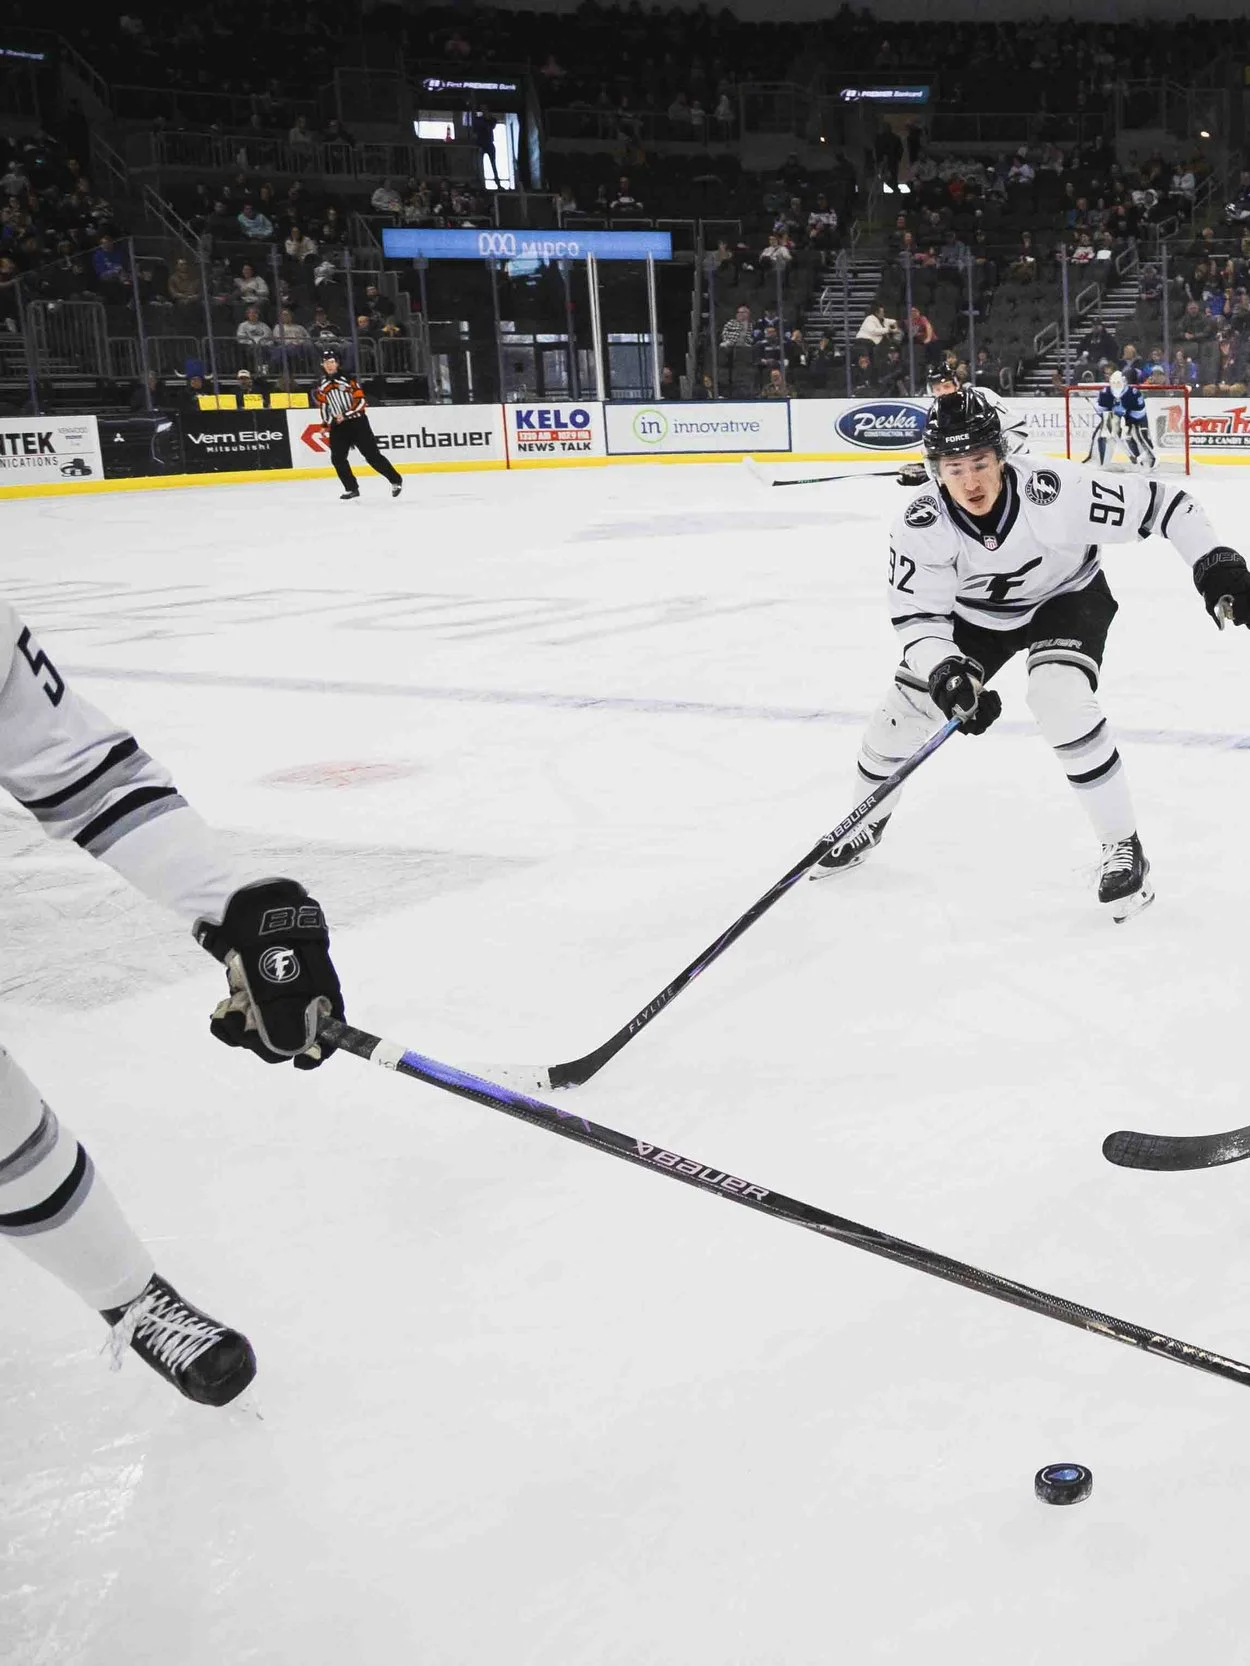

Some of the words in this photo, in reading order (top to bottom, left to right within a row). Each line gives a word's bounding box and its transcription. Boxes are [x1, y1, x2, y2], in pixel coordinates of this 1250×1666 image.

[515, 409, 590, 430] KELO
[674, 420, 760, 434] innovative
[853, 408, 918, 436] Peska
[187, 431, 236, 445] Vern
[238, 430, 284, 443] Eide
[374, 427, 492, 450] senbauer
[518, 442, 555, 452] NEWS
[560, 442, 591, 451] TALK
[945, 433, 970, 443] FORCE
[17, 625, 65, 708] 5
[627, 986, 675, 1034] FLYLITE
